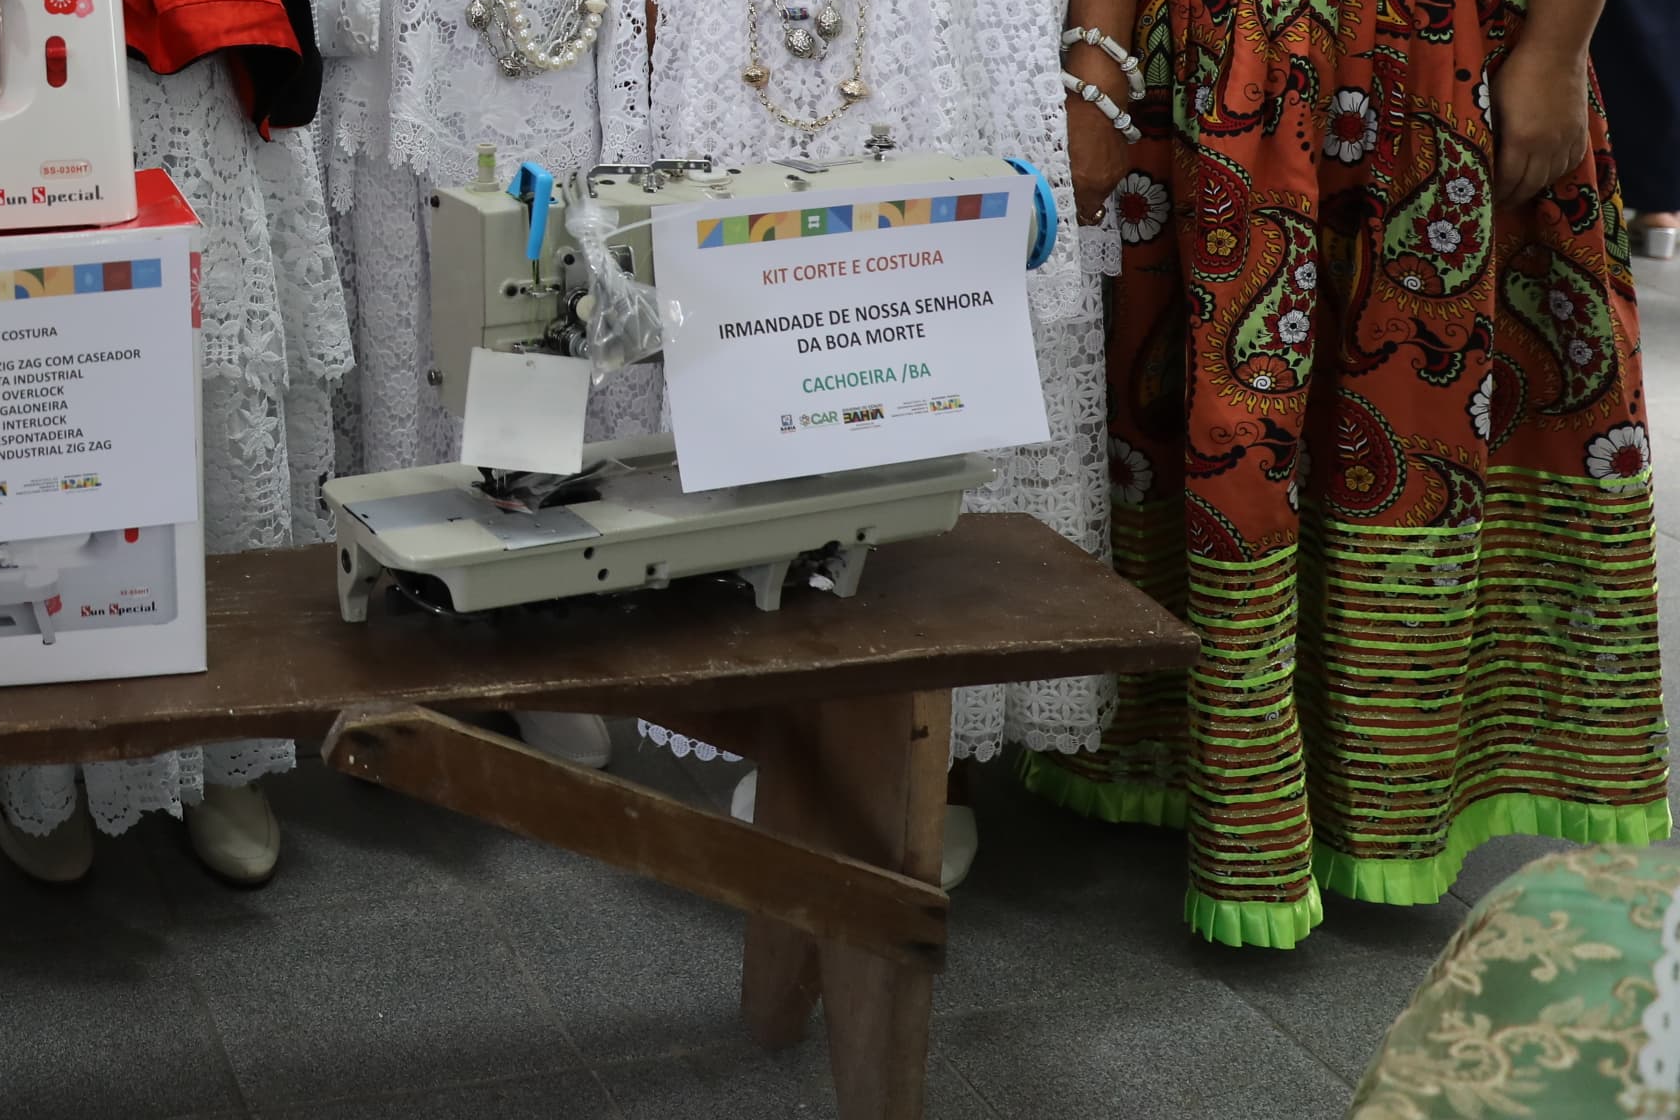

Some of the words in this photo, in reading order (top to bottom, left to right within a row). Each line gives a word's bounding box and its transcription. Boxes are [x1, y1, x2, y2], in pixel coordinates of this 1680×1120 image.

[762, 267, 789, 286] KIT
[793, 259, 847, 282] CORTE
[851, 259, 861, 275] E
[865, 249, 944, 272] COSTURA
[718, 312, 825, 340] IRMANDADE
[829, 307, 851, 325] DE
[855, 301, 911, 323] NOSSA
[915, 290, 994, 314] SENHORA
[2, 327, 58, 342] COSTURA
[797, 336, 822, 354] DA
[826, 329, 862, 351] BOA
[865, 323, 926, 346] MORTE
[18, 358, 42, 370] ZAG
[45, 355, 74, 367] COM
[77, 349, 141, 364] CASEADOR
[14, 369, 84, 385] INDUSTRIAL
[802, 367, 897, 394] CACHOEIRA
[901, 362, 932, 385] /BA
[2, 386, 64, 401] OVERLOCK
[0, 400, 68, 416] GALONEIRA
[3, 415, 67, 430] INTERLOCK
[811, 411, 838, 425] CAR
[843, 408, 885, 424] BAHIA
[66, 443, 85, 454] ZIG
[88, 440, 112, 451] ZAG
